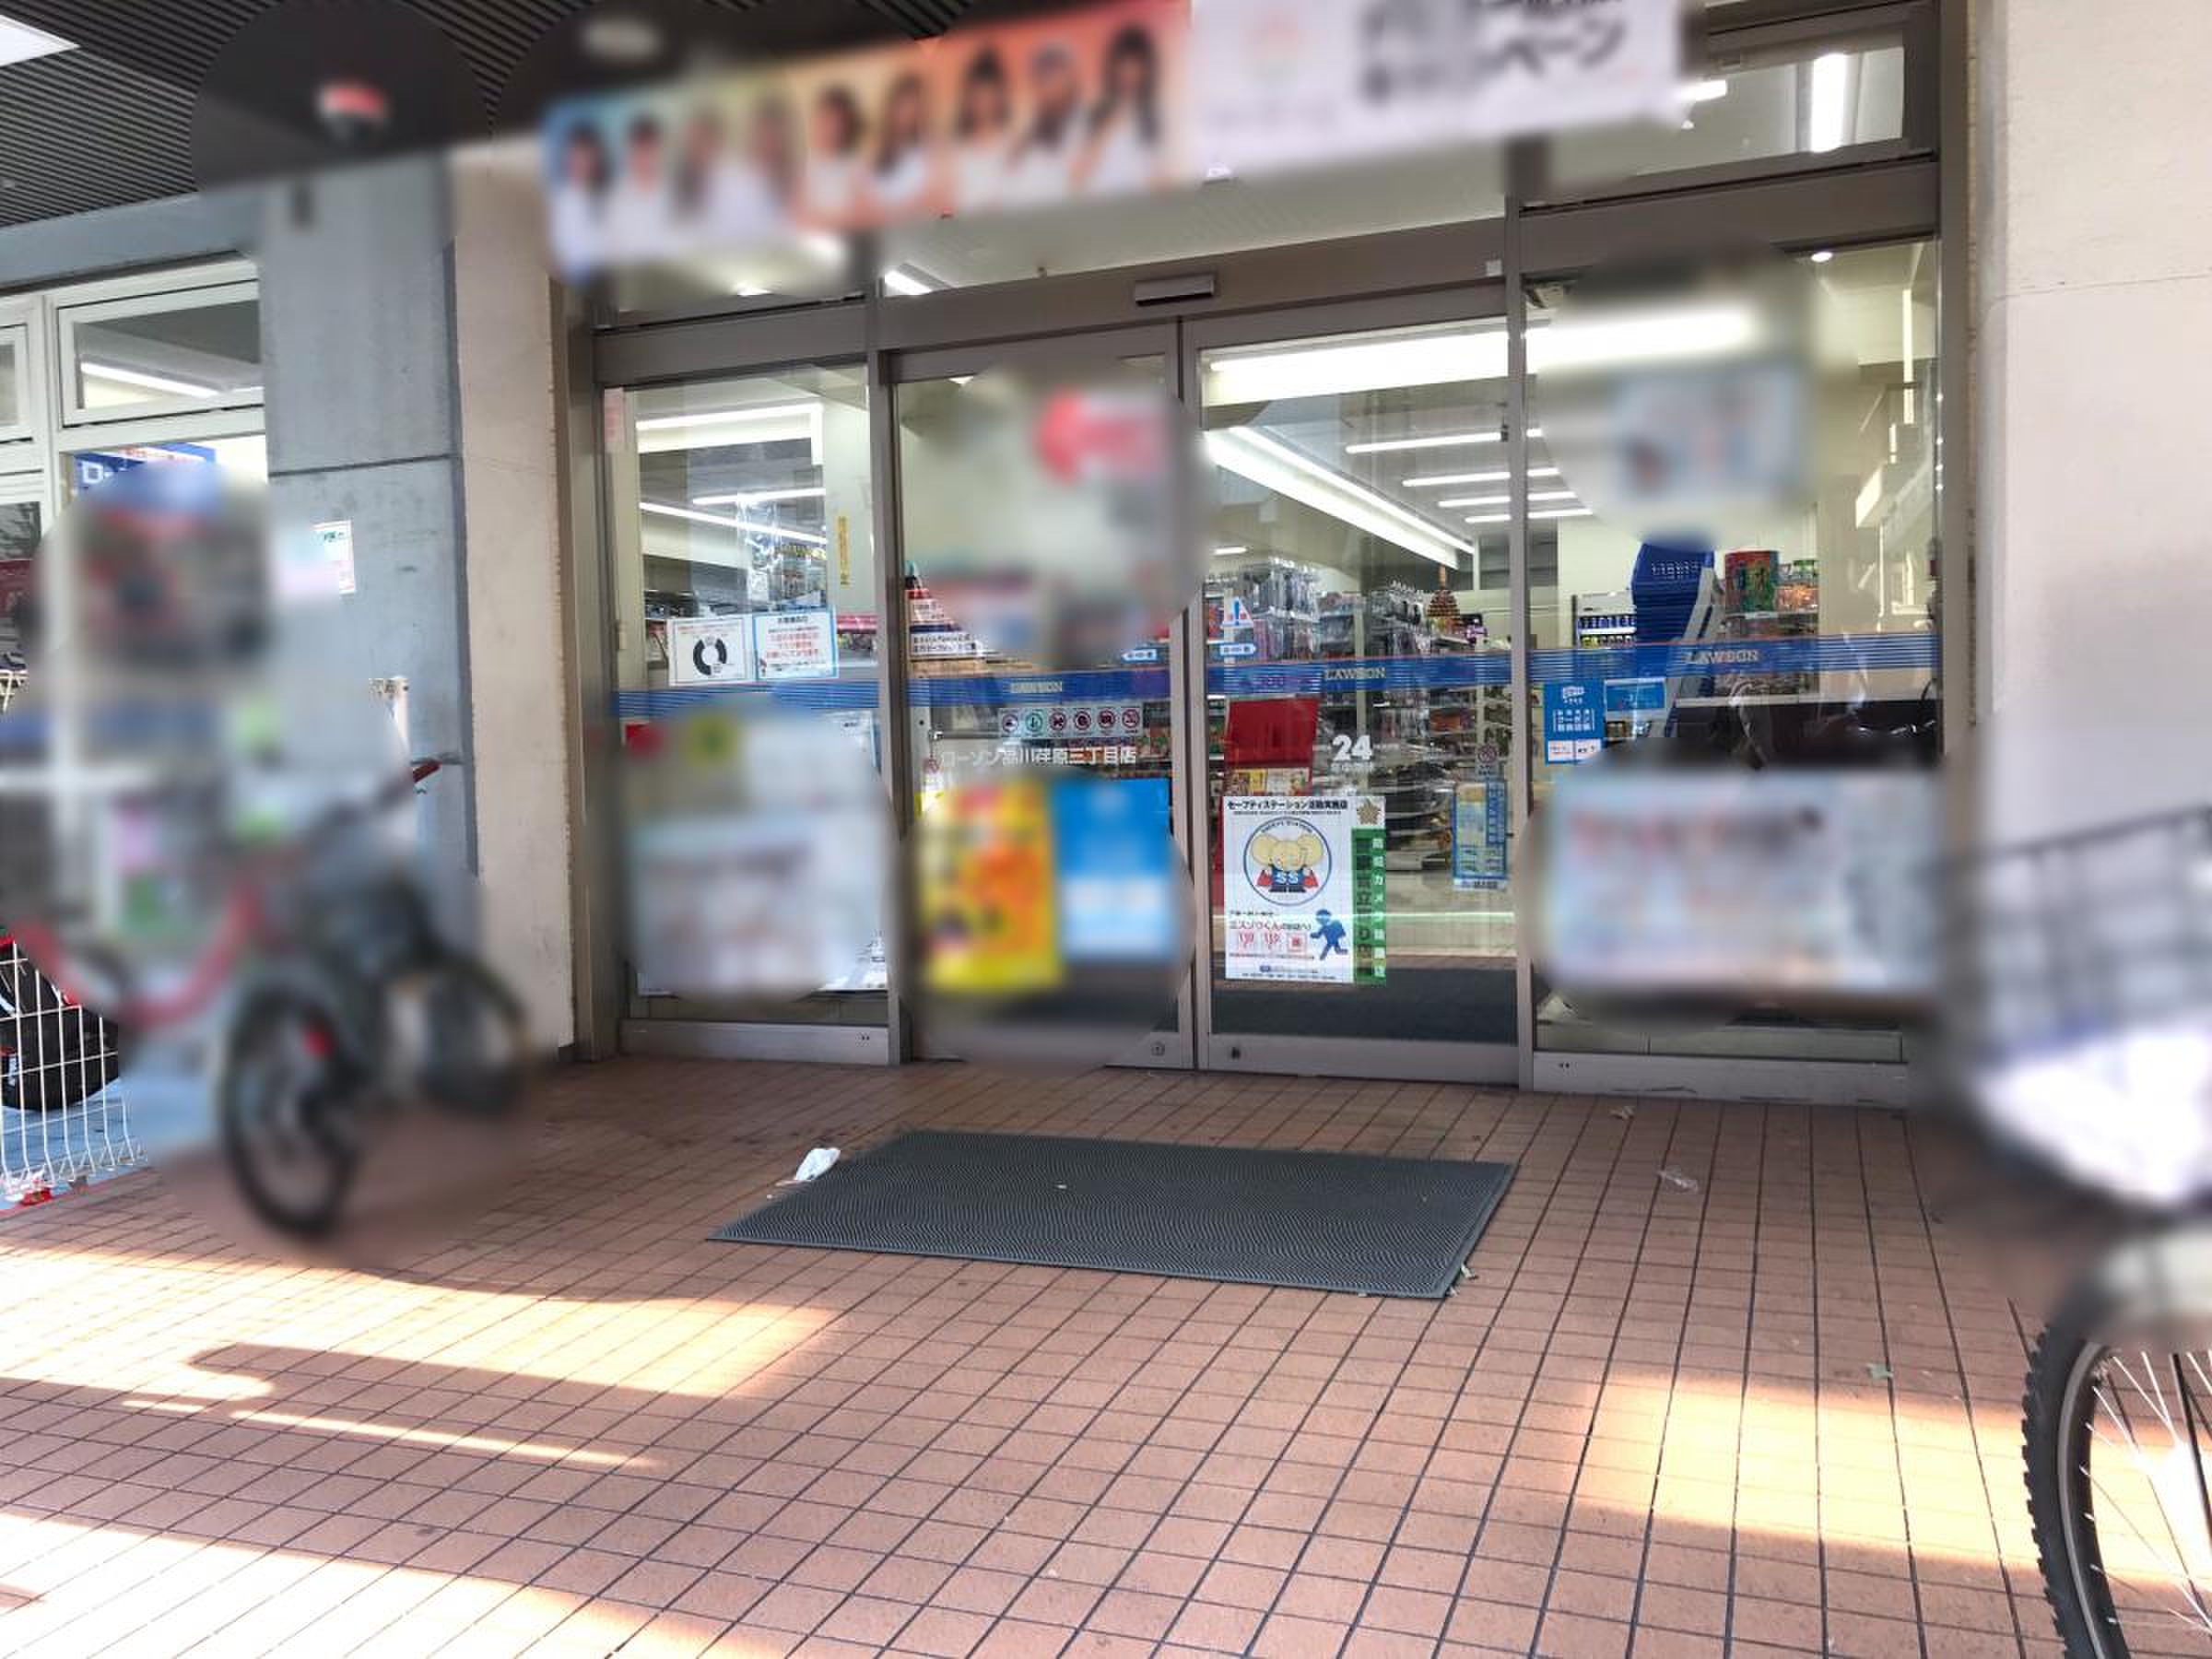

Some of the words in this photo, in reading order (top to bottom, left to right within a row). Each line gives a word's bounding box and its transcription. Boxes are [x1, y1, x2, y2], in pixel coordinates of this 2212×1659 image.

[1684, 649, 1759, 664] LAWSON
[1324, 667, 1385, 679] LAWSON
[1332, 734, 1373, 761] 24
